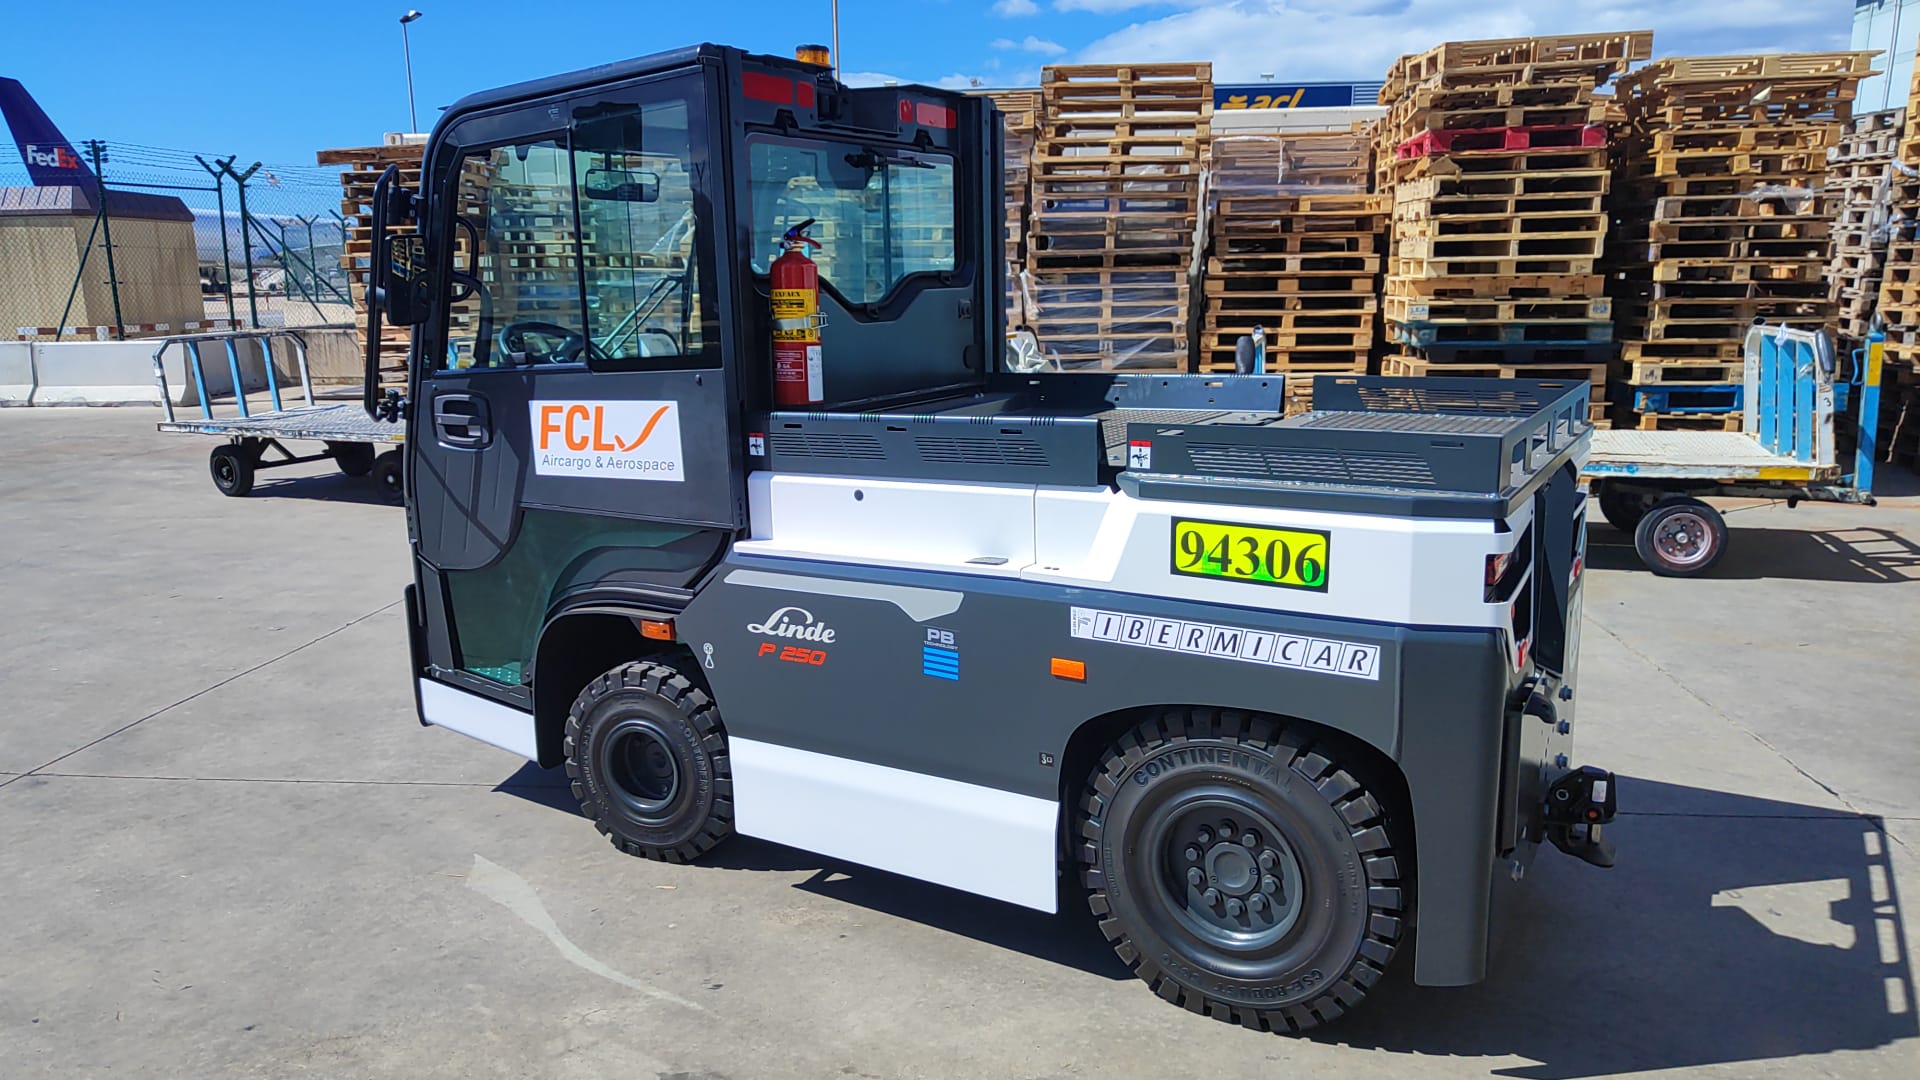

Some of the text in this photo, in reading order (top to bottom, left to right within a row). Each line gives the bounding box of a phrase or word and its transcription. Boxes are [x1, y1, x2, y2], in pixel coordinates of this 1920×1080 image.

[26, 144, 80, 170] FedEx
[539, 404, 616, 452] FCL
[541, 454, 676, 473] Aircargo & Aerospace
[1179, 529, 1323, 585] 94306
[746, 606, 837, 644] Linde
[927, 628, 955, 645] PB
[1102, 616, 1370, 671] IBERMICAR
[757, 642, 828, 666] P 250
[1133, 747, 1292, 794] CONTINENTAL
